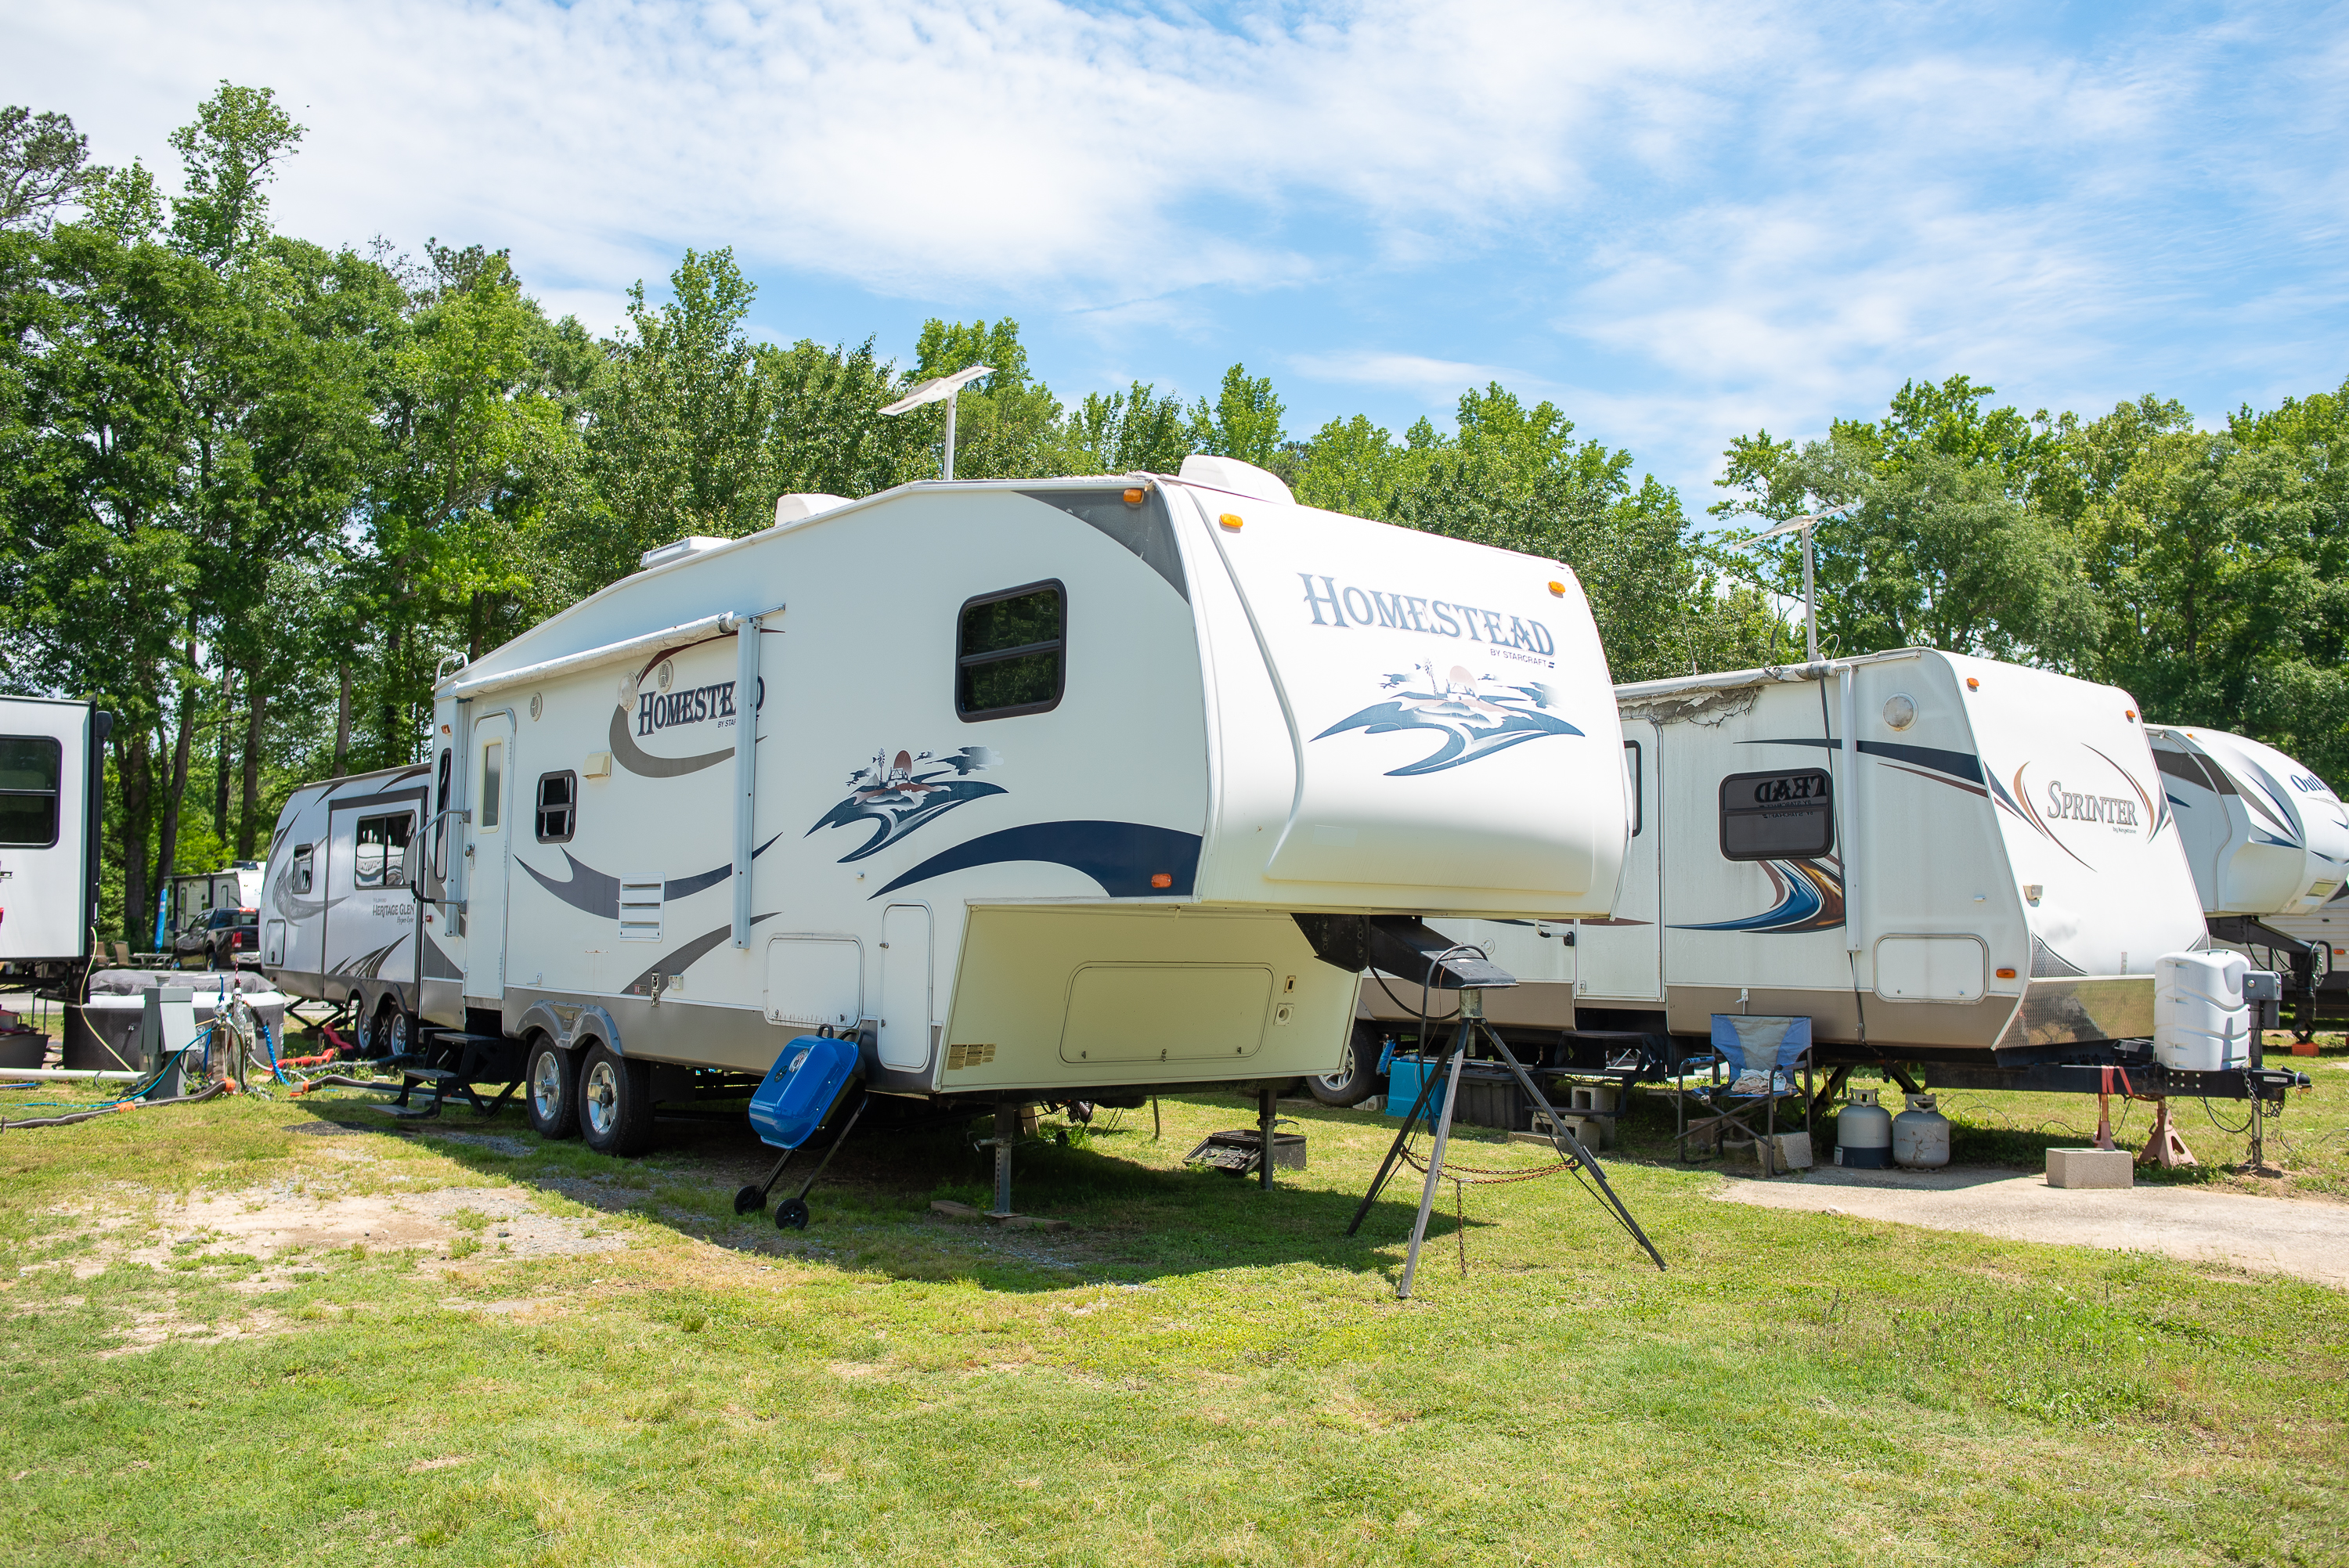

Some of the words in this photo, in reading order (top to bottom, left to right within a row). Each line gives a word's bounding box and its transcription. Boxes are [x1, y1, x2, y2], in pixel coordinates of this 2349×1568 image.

[1297, 572, 1555, 656] HOMESTEAD
[1490, 648, 1500, 657] BY
[1503, 651, 1547, 667] STARCRAFT
[637, 675, 766, 737] HOMESTED
[2047, 780, 2138, 827] SPRINTER
[373, 904, 399, 918] HERITAGE
[399, 903, 415, 916] GLEN
